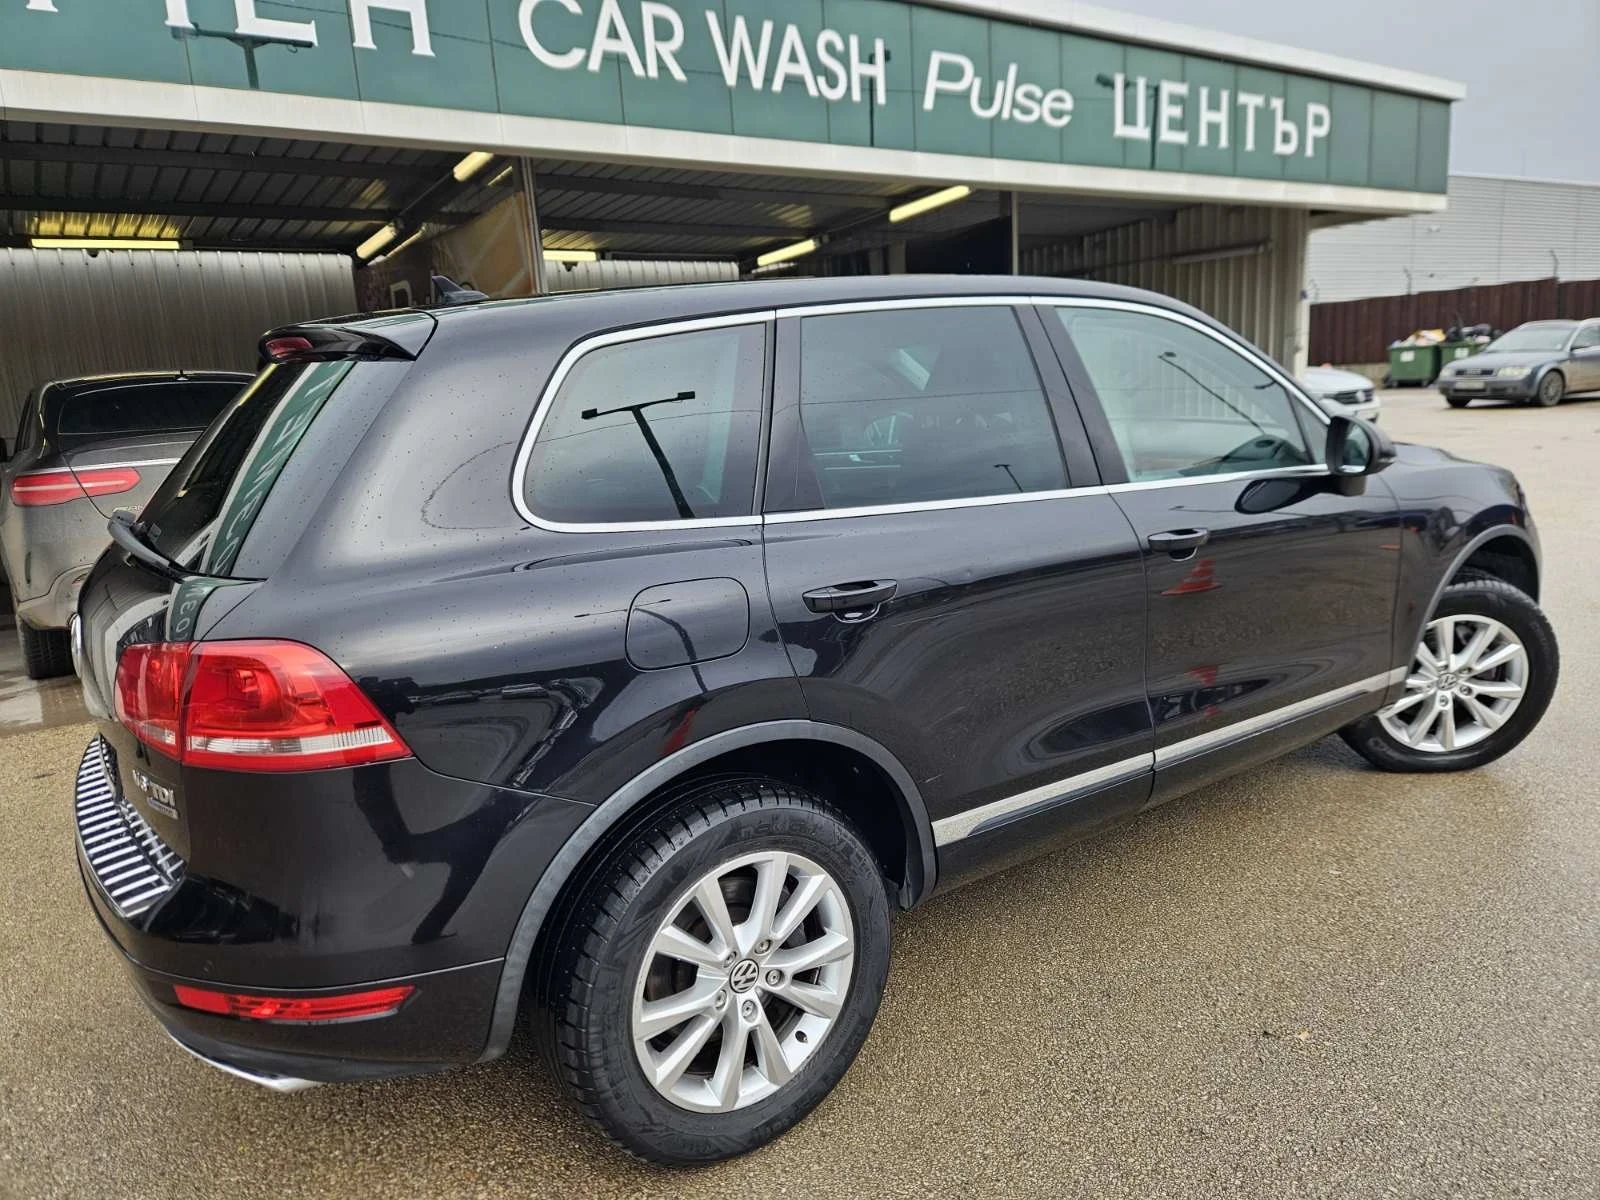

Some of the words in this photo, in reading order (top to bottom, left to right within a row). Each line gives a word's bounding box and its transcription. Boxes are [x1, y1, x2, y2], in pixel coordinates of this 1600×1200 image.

[518, 0, 688, 82] CAR
[705, 10, 887, 106] WASH
[922, 50, 1074, 128] Pulse
[1113, 72, 1331, 157] ЦЕНТЪР
[149, 780, 176, 807] TDI
